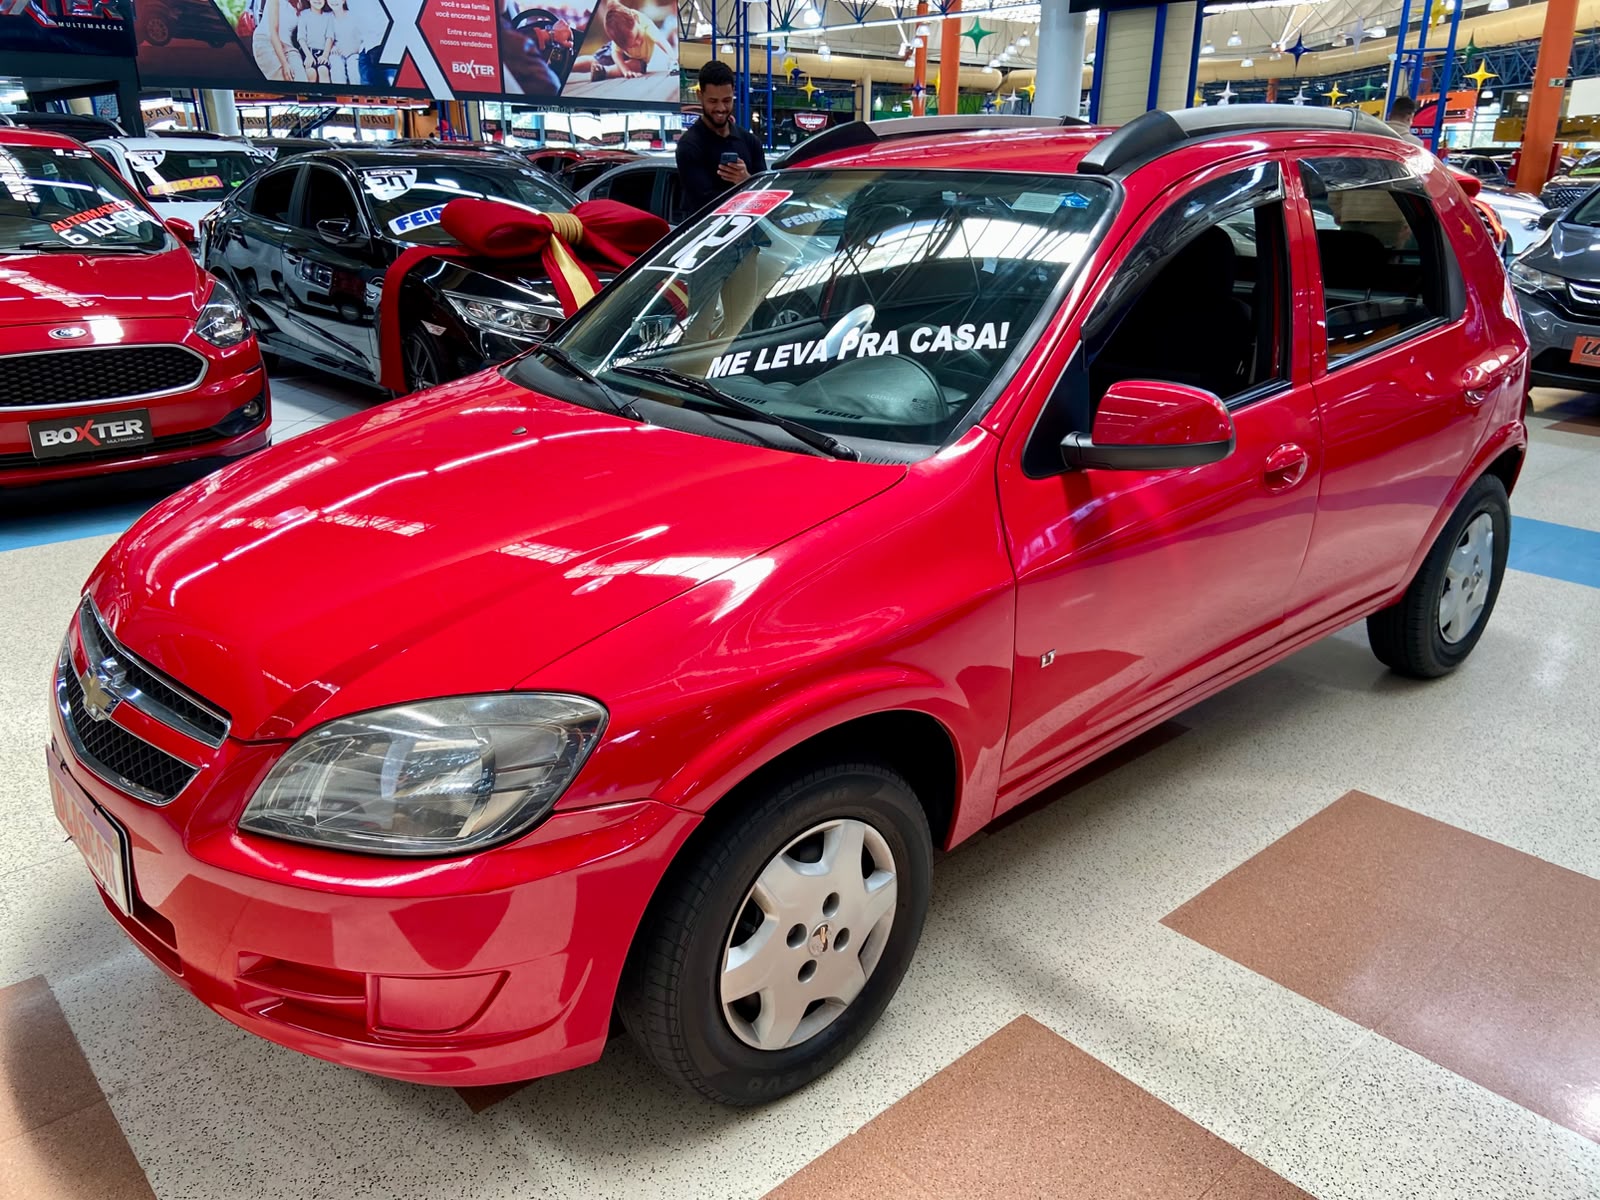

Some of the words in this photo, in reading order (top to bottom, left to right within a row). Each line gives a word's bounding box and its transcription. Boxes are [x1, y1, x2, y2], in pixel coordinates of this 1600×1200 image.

[58, 21, 124, 31] MULTIMARCAS
[447, 28, 462, 36] Entre
[460, 41, 493, 49] vendedores
[452, 59, 495, 79] BOXTER
[705, 351, 752, 379] ME
[754, 339, 829, 371] LEVA
[837, 328, 899, 360] PRA
[910, 322, 1010, 353] CASA!
[39, 419, 145, 447] BOXTER
